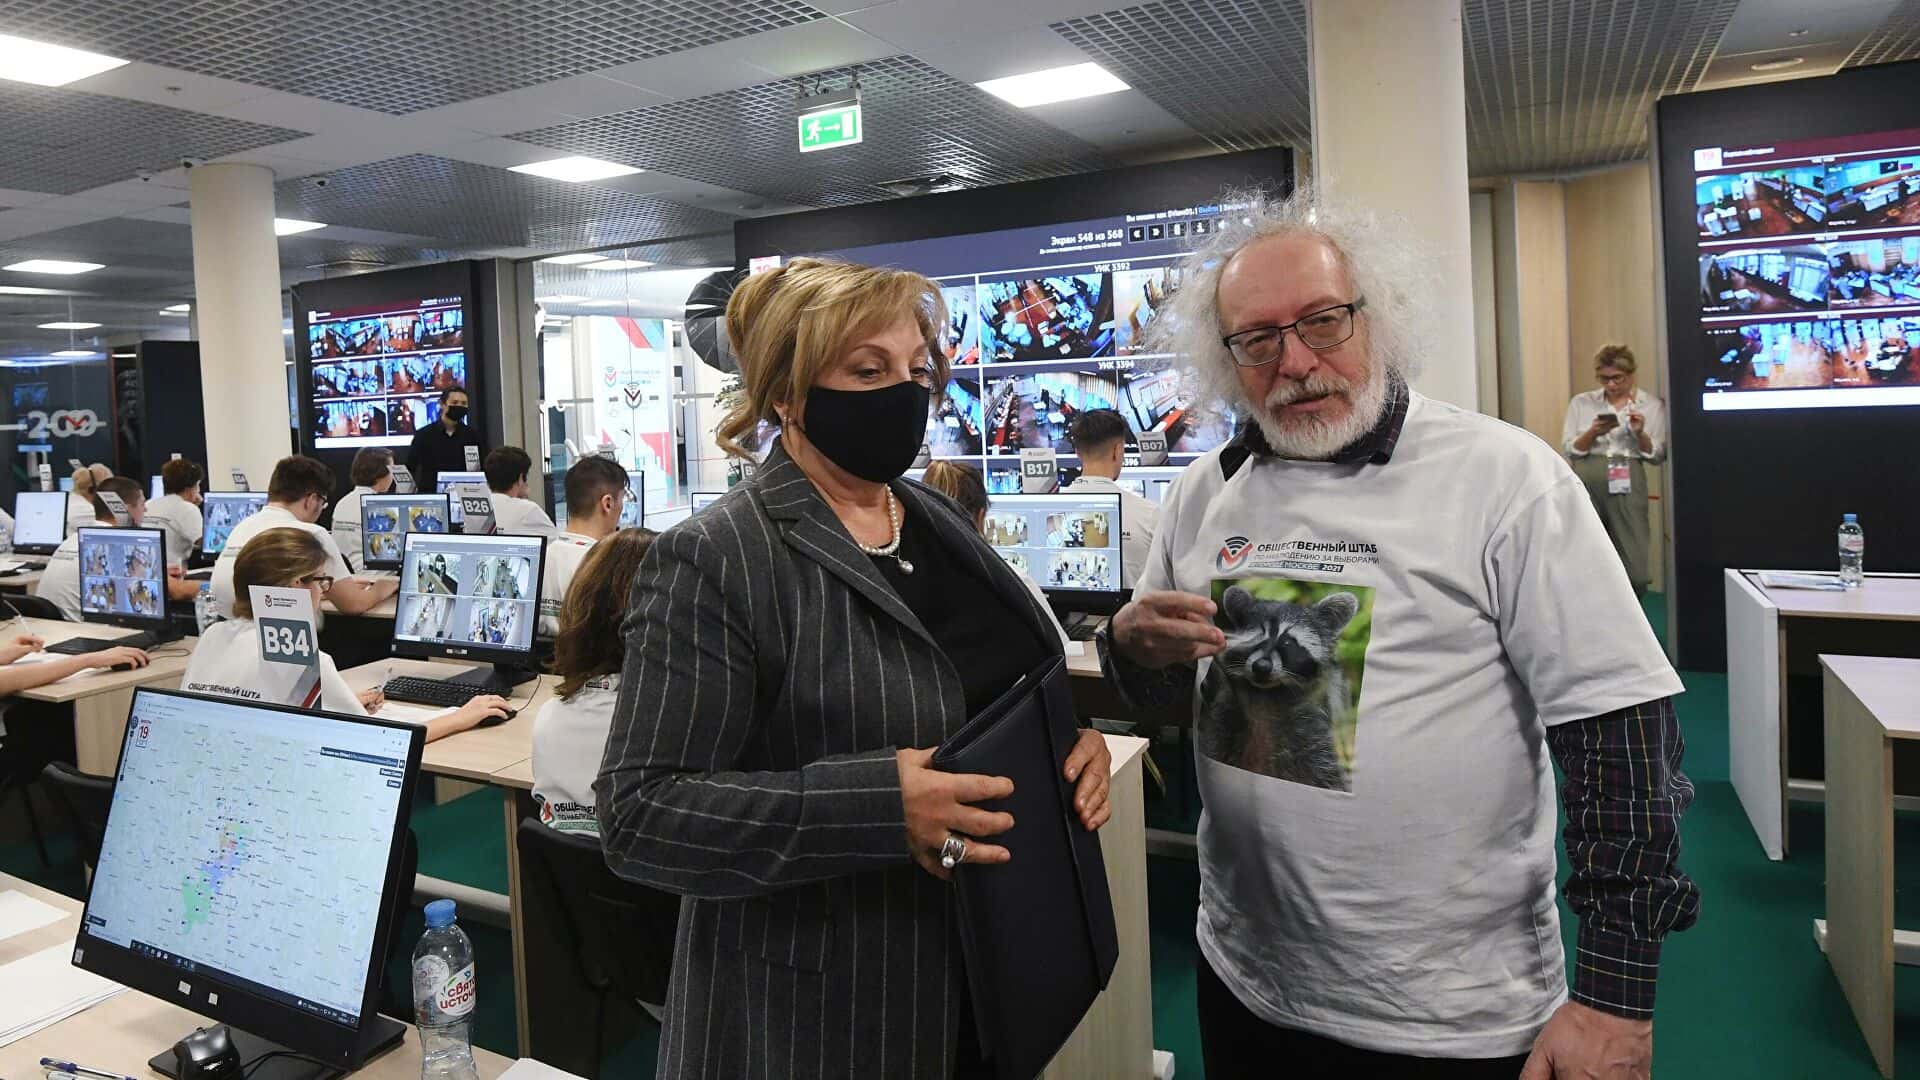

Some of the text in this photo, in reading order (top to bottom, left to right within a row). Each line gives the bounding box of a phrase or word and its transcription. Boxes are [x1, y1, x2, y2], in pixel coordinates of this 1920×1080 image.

[1051, 229, 1124, 246] Экран 548 из 568
[1122, 458, 1139, 466] 396
[1026, 463, 1051, 475] B17
[463, 500, 490, 513] B26
[1257, 540, 1378, 553] ОБЩЕСТВЕННЫЙ ШТАБ
[1321, 564, 1341, 572] 2021
[263, 625, 310, 657] B34
[140, 726, 148, 739] 19
